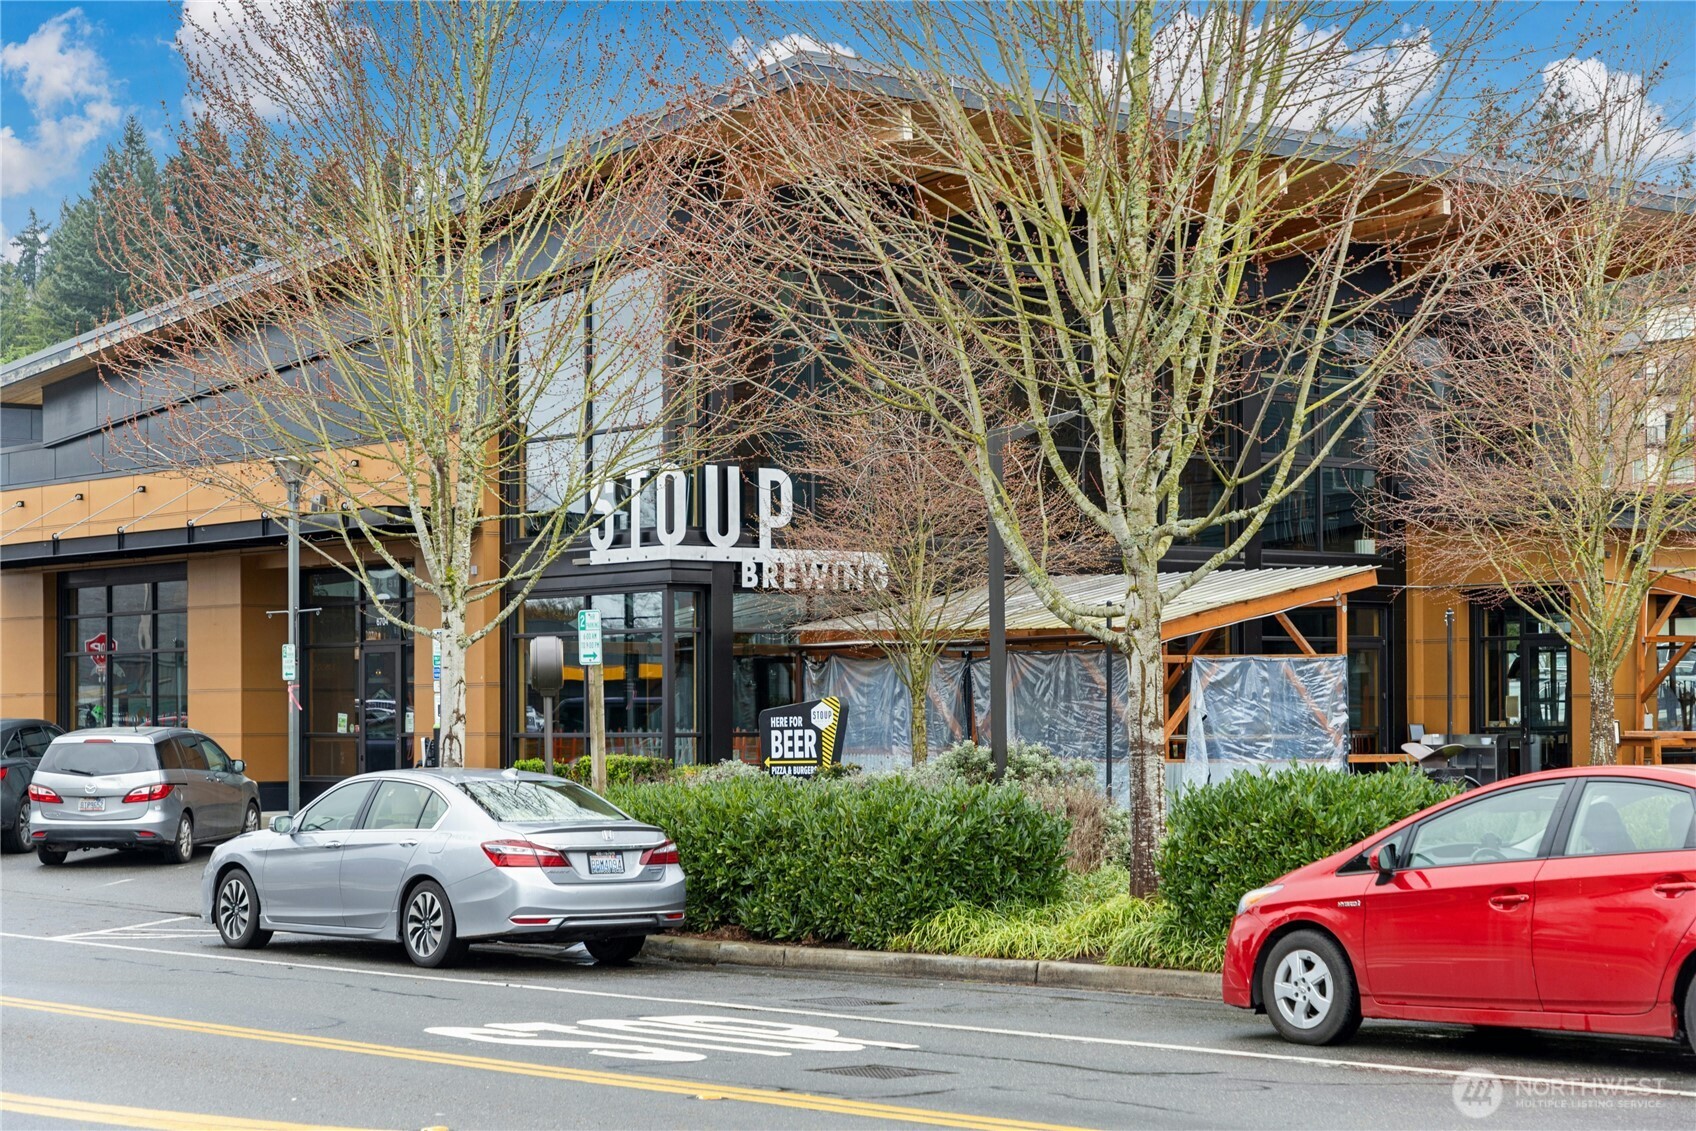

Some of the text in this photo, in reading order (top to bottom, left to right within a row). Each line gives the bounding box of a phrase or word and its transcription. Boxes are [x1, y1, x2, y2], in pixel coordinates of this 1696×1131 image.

[590, 462, 793, 551] STOUP
[741, 561, 889, 590] BREWING
[580, 614, 586, 628] 2
[770, 715, 803, 728] HERE FOR
[812, 710, 832, 720] STOUP
[770, 729, 817, 759] BEER
[771, 765, 786, 775] PIZZA
